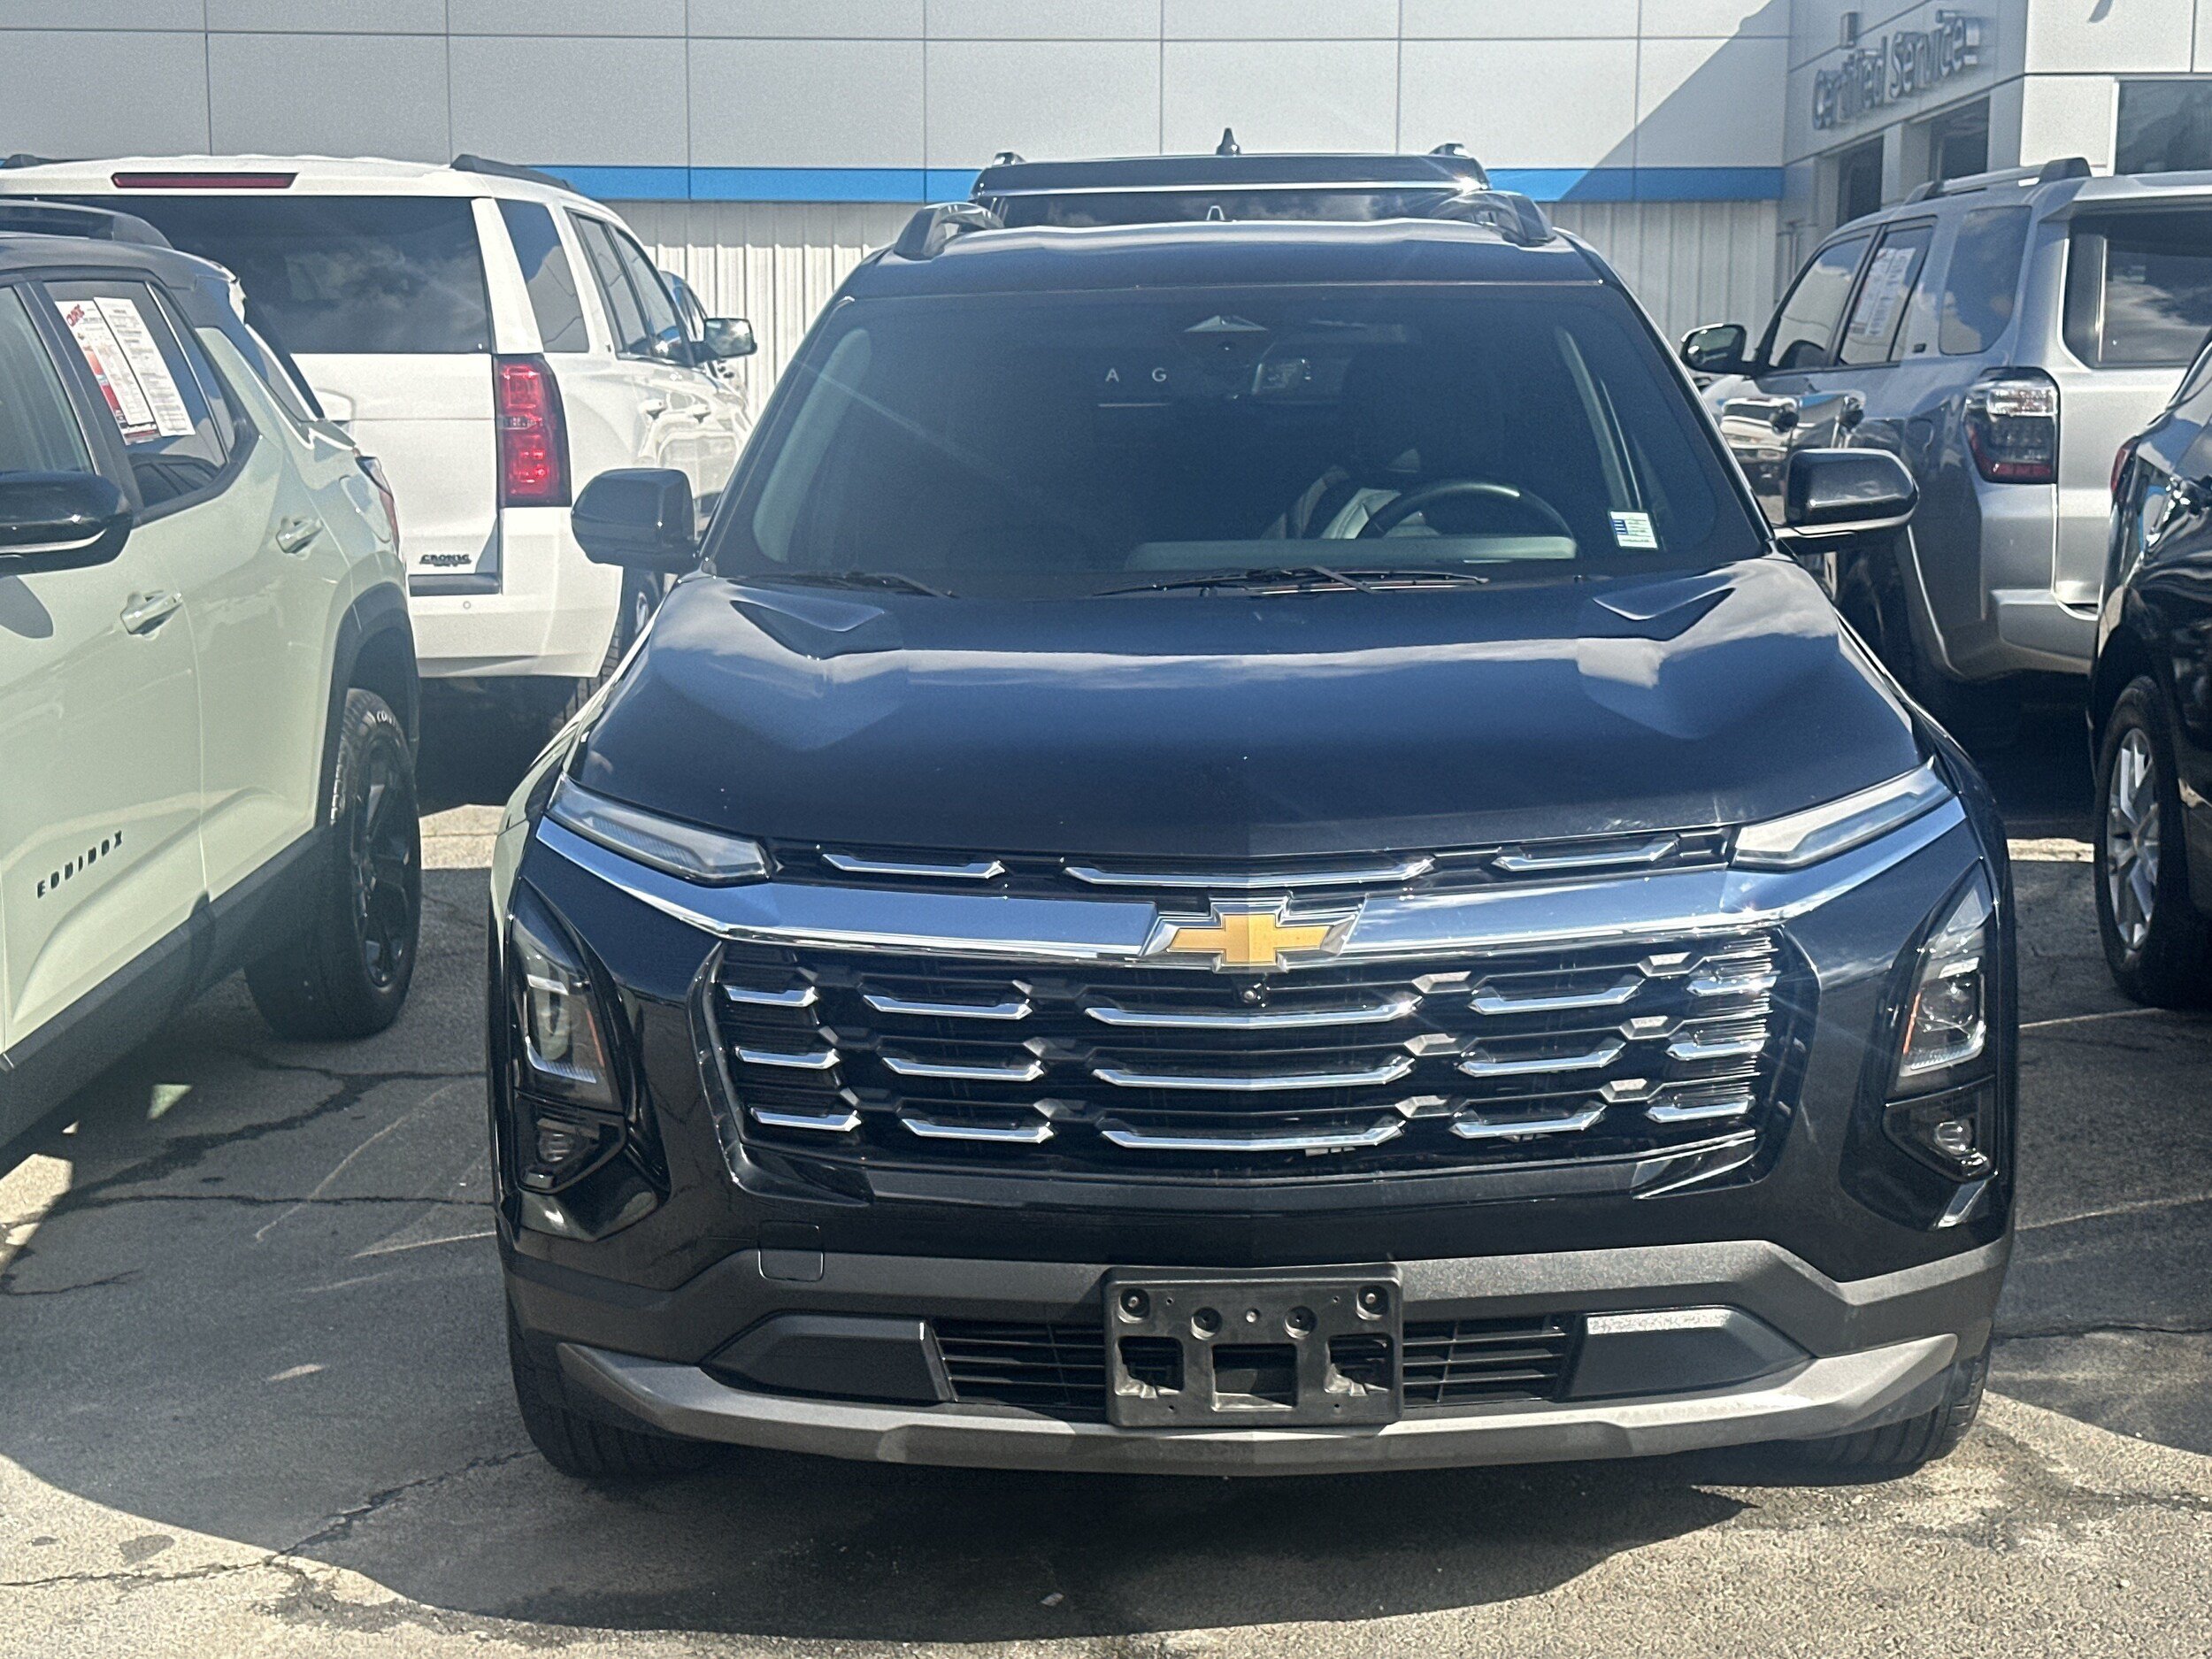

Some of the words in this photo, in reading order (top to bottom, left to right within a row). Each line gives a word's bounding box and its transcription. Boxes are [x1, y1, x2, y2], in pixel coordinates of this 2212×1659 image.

[1105, 367, 1120, 382] A
[1152, 367, 1167, 382] G
[36, 829, 123, 899] EQUINOX
